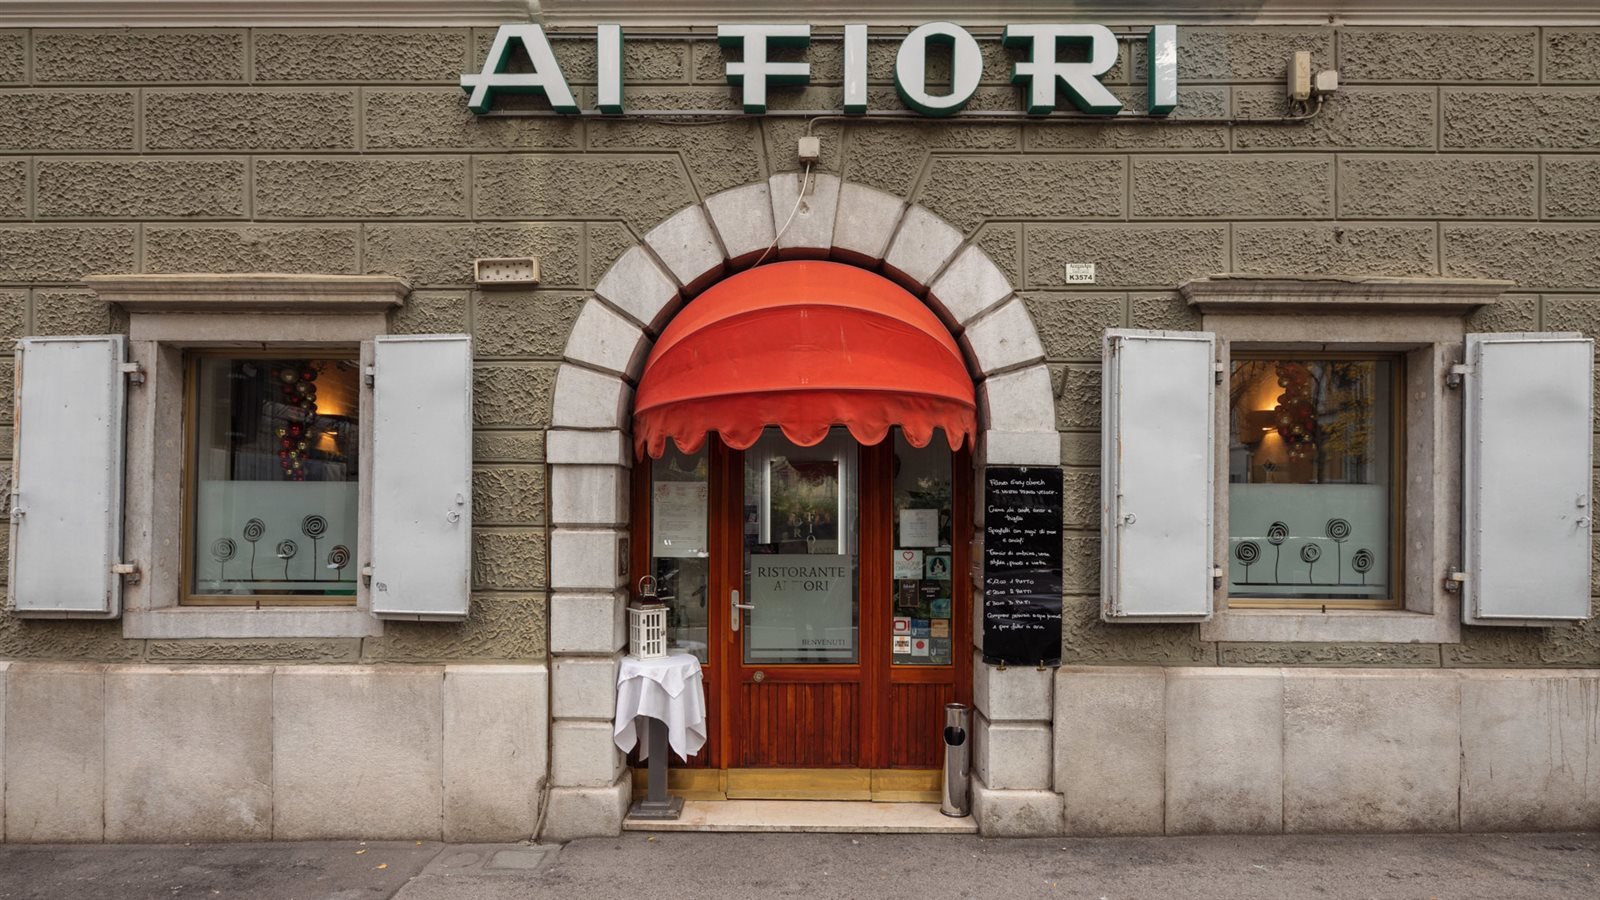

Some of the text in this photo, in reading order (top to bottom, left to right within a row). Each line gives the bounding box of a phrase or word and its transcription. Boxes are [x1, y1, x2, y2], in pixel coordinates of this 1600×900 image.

[460, 22, 1178, 118] AI FIORI
[757, 566, 846, 578] RISTORANTE
